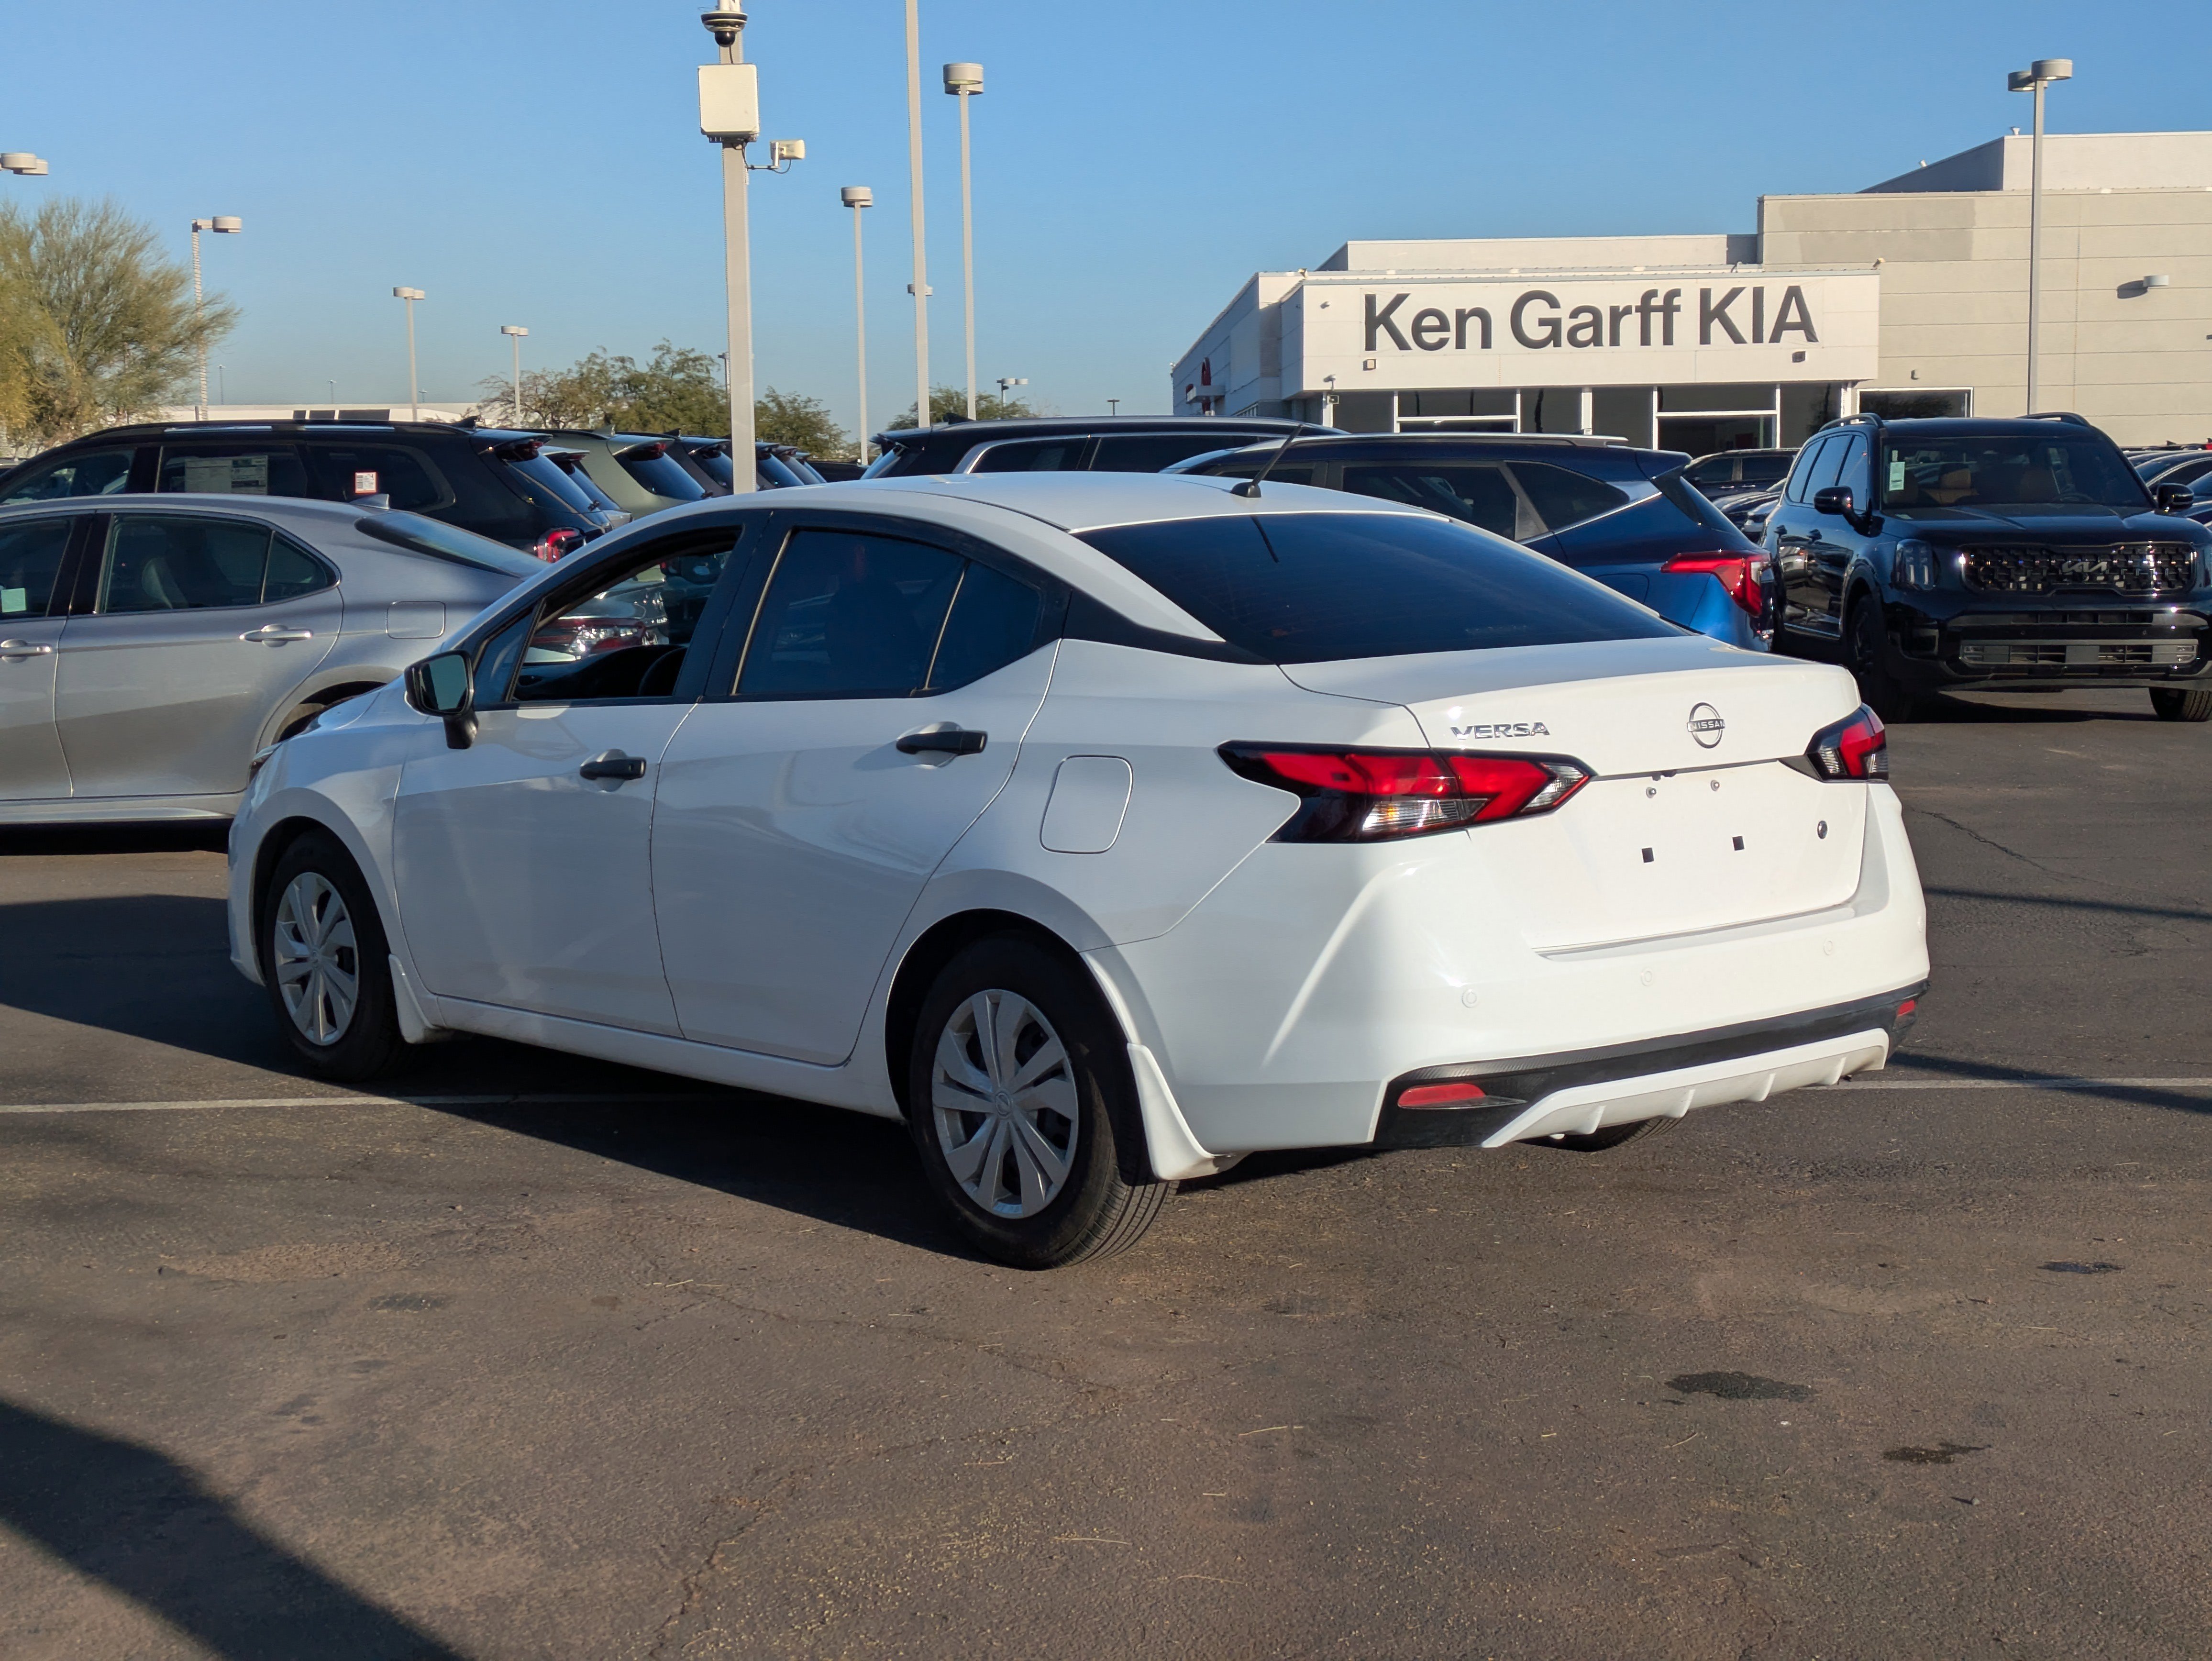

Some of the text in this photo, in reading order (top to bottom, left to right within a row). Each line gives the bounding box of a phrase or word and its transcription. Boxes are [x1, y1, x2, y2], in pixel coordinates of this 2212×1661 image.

[1365, 286, 1819, 351] Ken Garff KIA
[1450, 722, 1550, 740] VERSA
[1691, 720, 1725, 729] NISSAN
